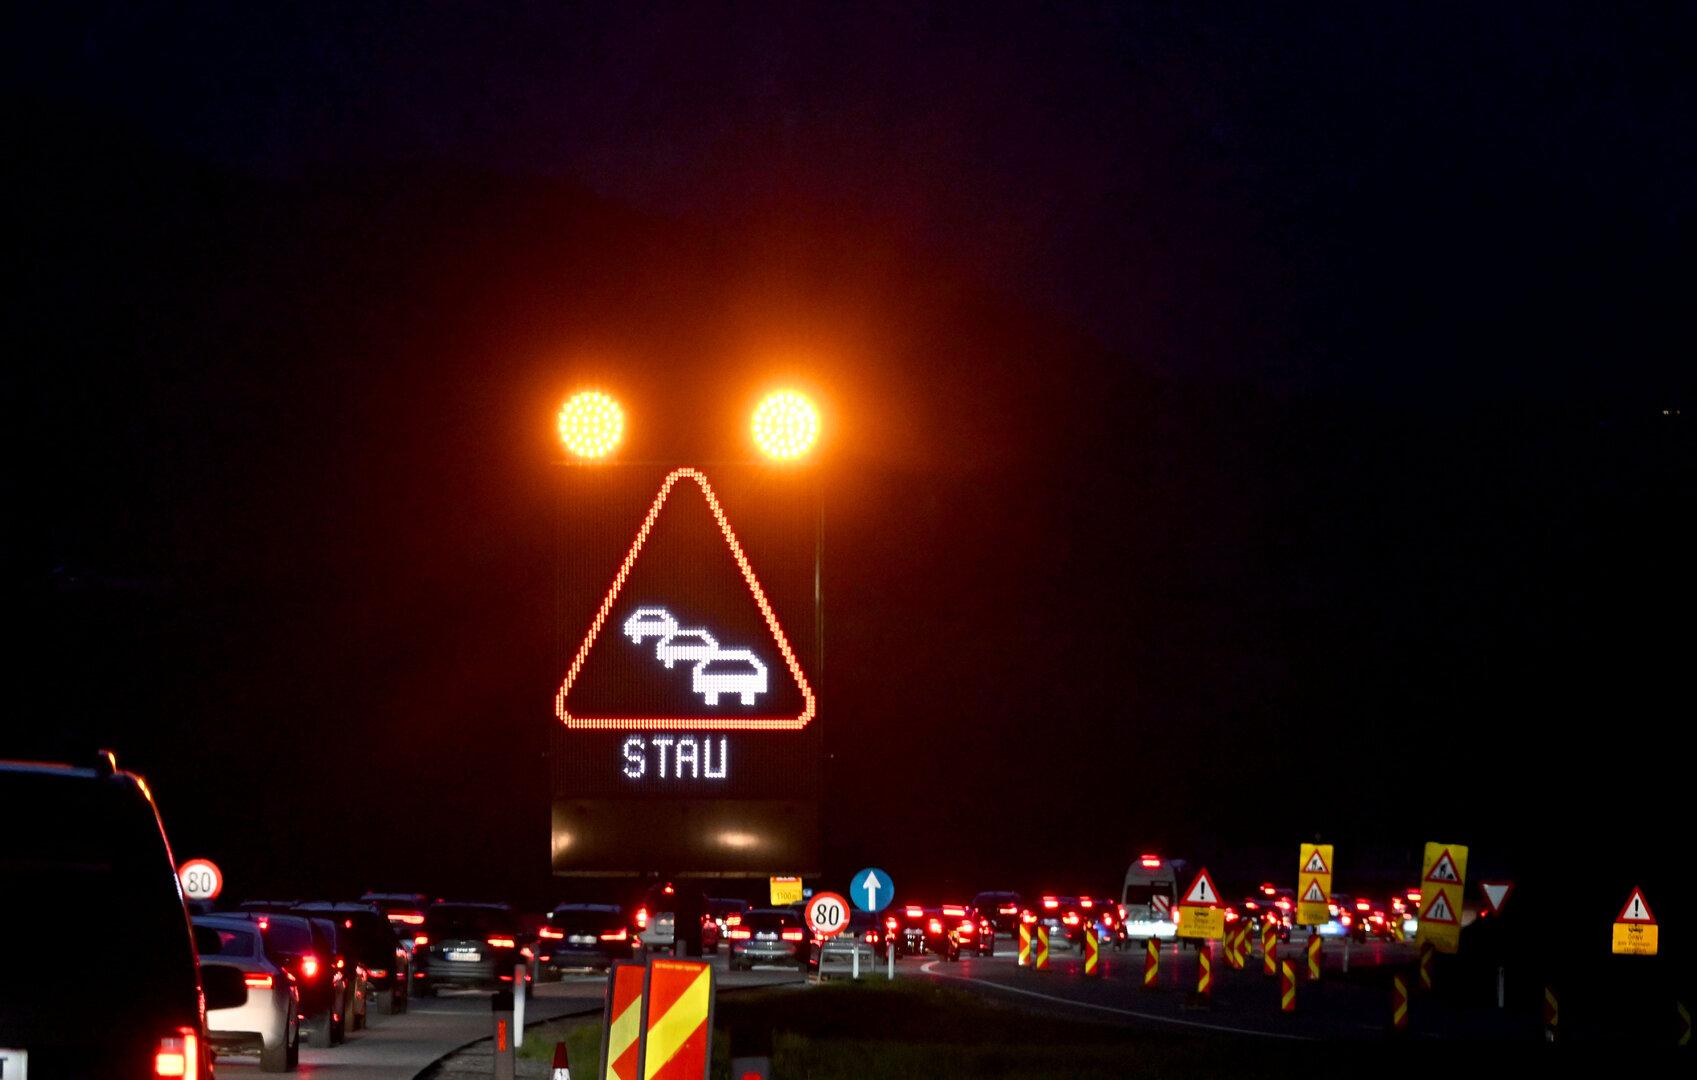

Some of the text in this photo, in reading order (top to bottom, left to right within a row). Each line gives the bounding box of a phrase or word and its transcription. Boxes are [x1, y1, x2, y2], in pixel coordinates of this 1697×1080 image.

[623, 737, 726, 779] STAU
[188, 871, 211, 893] 80
[815, 903, 840, 926] 80
